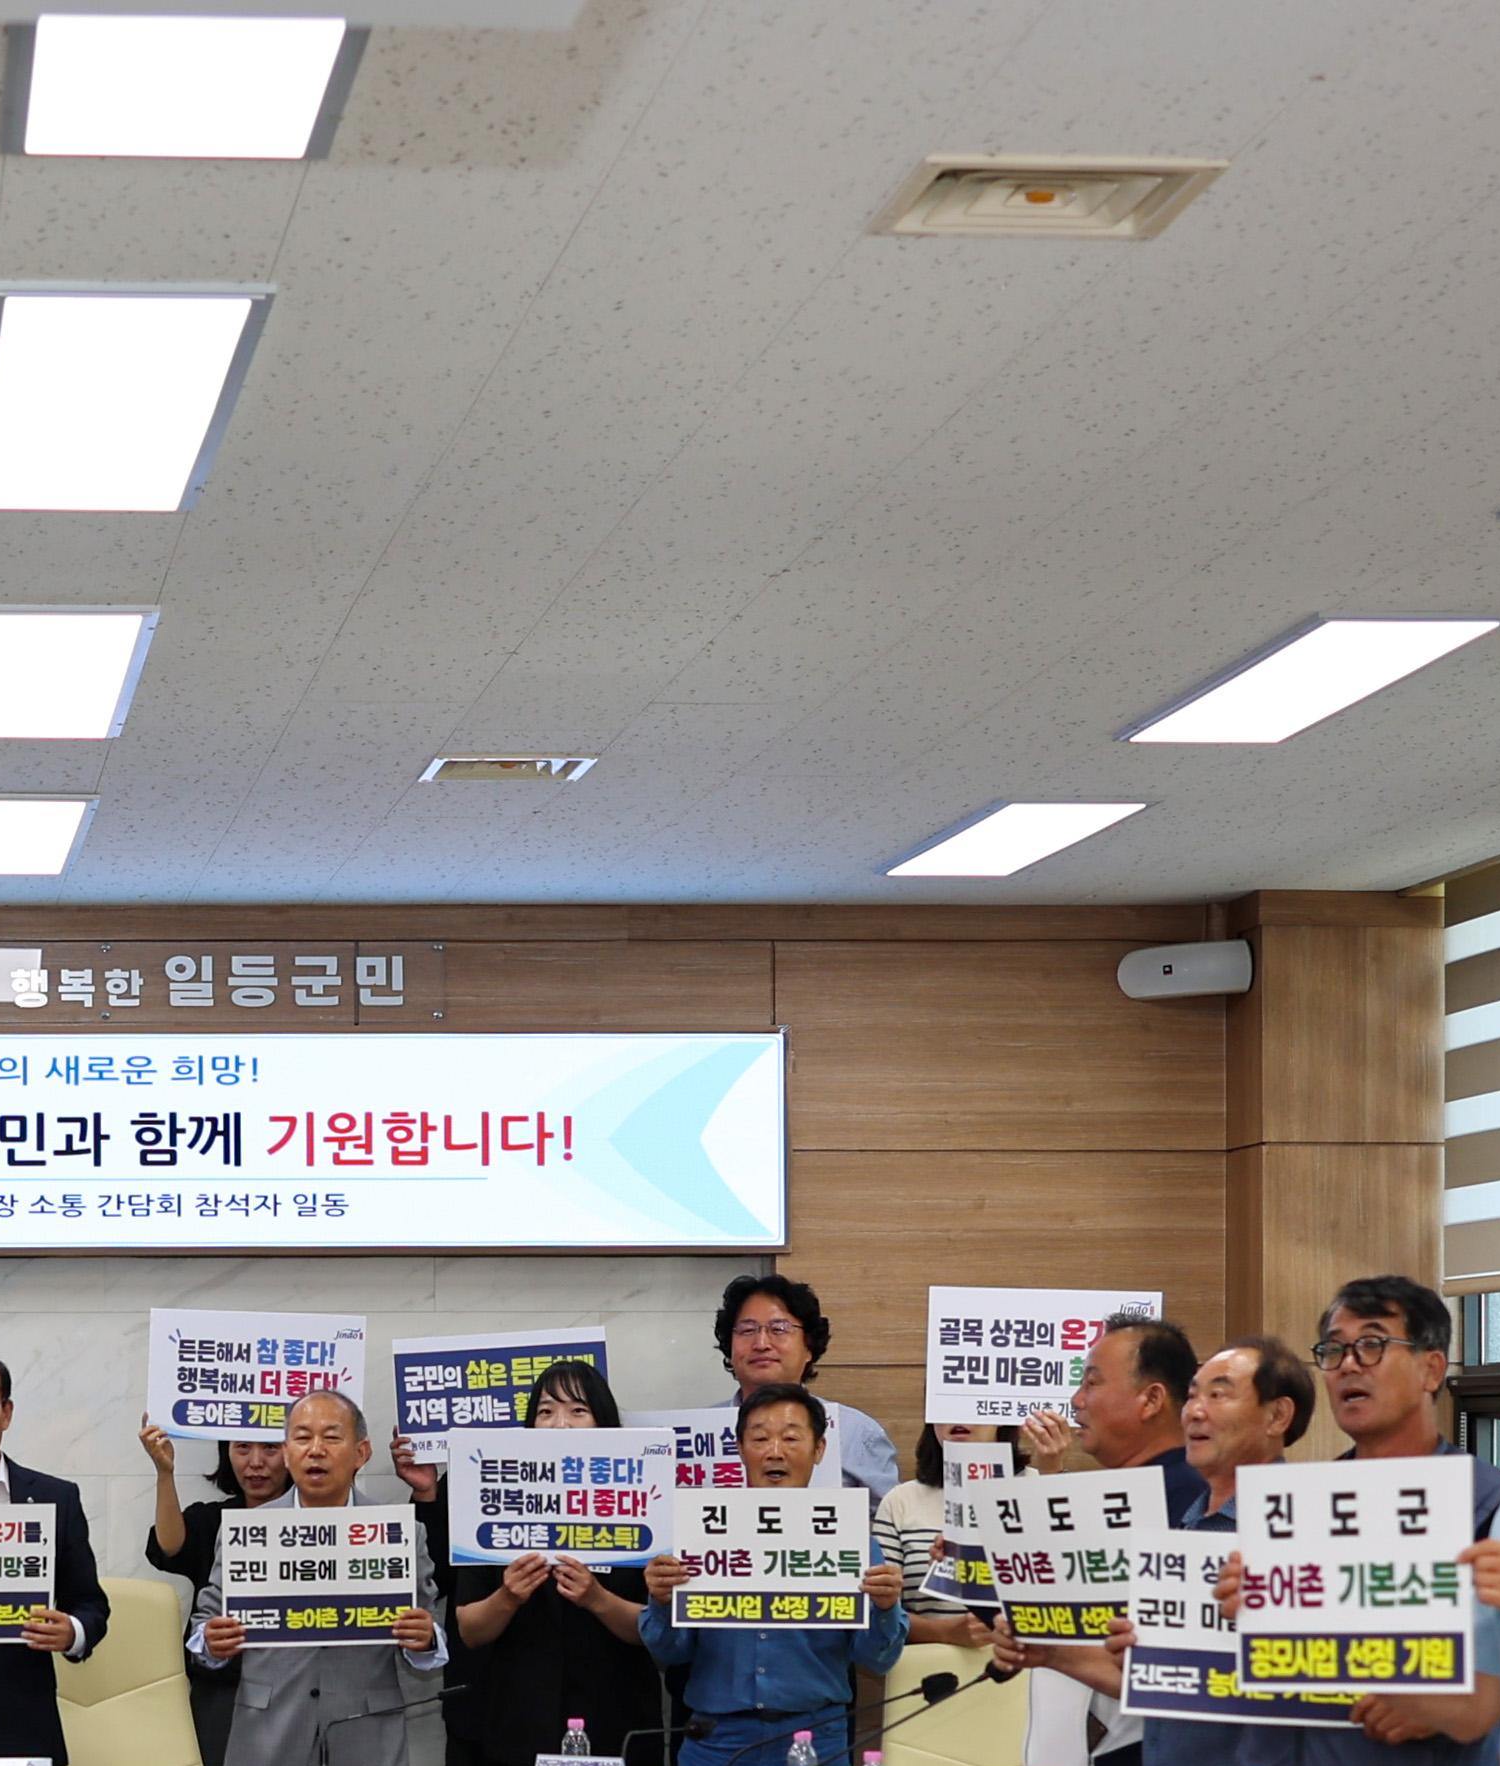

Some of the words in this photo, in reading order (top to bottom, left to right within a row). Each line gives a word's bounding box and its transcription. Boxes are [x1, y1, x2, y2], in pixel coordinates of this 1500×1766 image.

[10, 968, 145, 1009] 행복한
[165, 955, 406, 1009] 일등군민
[45, 1055, 157, 1087] 새로운
[171, 1054, 260, 1087] 희망!
[130, 1112, 242, 1168] 함께
[266, 1112, 574, 1168] 기원합니다!
[29, 1194, 86, 1218] 소통
[97, 1193, 183, 1218] 간담회
[194, 1194, 281, 1218] 참석자
[292, 1194, 349, 1218] 일동
[940, 1318, 983, 1346] 골목
[990, 1319, 1054, 1347] 상권의
[178, 1339, 251, 1363] 든든해서
[257, 1338, 279, 1364] 참
[284, 1339, 336, 1366] 좋다!
[177, 1367, 255, 1394] 행복해서
[260, 1371, 281, 1395] 더
[404, 1365, 462, 1392] 군민의
[466, 1359, 507, 1389] 삶은
[943, 1355, 989, 1384] 군민
[996, 1357, 1063, 1386] 마음에
[187, 1402, 242, 1425] 농어촌
[406, 1398, 447, 1426] 지역
[452, 1395, 510, 1424] 경제는
[976, 1401, 1012, 1416] 진도군
[480, 1459, 555, 1483] 든든해서
[561, 1457, 584, 1484] 참
[590, 1457, 643, 1484] 좋다!
[480, 1488, 561, 1516] 행복해서
[566, 1490, 587, 1516] 더
[593, 1489, 647, 1517] 좋다!
[229, 1526, 267, 1547] 지역
[279, 1525, 336, 1547] 상권에
[348, 1523, 409, 1546] 온기를,
[491, 1525, 549, 1548] 농어촌
[555, 1525, 640, 1549] 기본소득!
[229, 1561, 267, 1582] 군민
[280, 1560, 336, 1581] 마음에
[348, 1558, 409, 1580] 희망을!
[680, 1549, 752, 1577] 농어촌
[763, 1550, 861, 1577] 기본소득
[1139, 1552, 1186, 1581] 지역
[1243, 1563, 1324, 1609] 농어촌
[1339, 1562, 1460, 1607] 기본소득
[286, 1608, 338, 1629] 농어촌
[686, 1596, 761, 1619] 공모사업
[770, 1596, 808, 1619] 선정
[816, 1596, 855, 1619] 기원
[1137, 1598, 1185, 1628] 군민
[1250, 1639, 1338, 1678] 공모사업
[1346, 1638, 1396, 1679] 선정
[1402, 1638, 1454, 1678] 기원
[1131, 1664, 1200, 1695] 진도군
